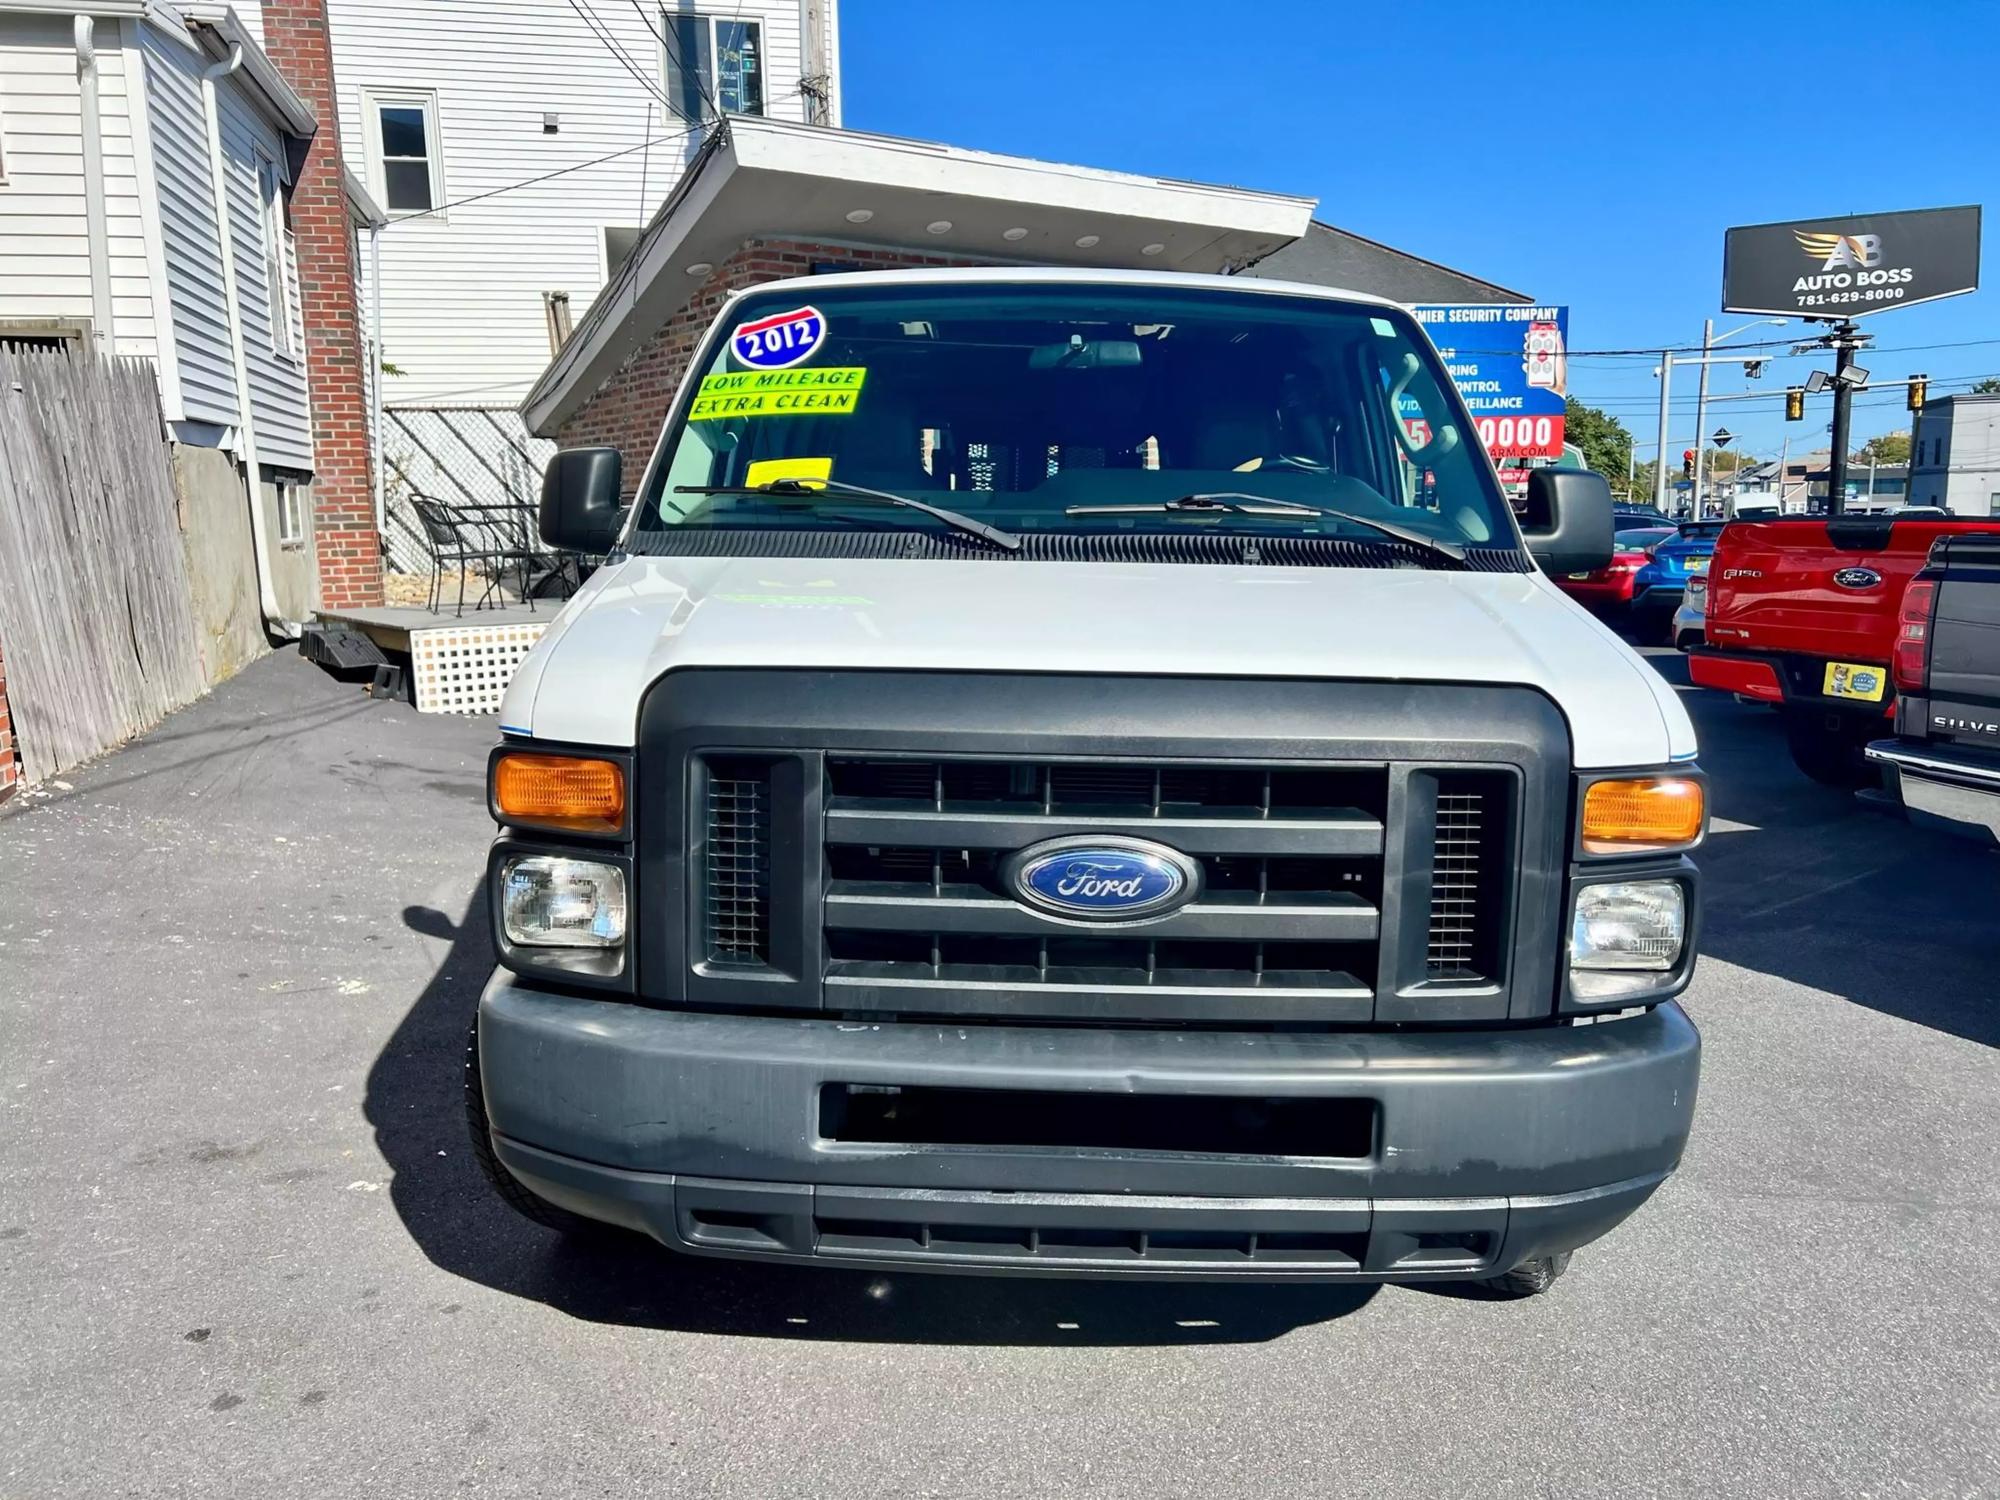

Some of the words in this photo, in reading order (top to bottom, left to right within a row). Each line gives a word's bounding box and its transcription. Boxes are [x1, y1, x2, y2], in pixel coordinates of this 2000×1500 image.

[1792, 273, 1852, 292] AUTO
[1857, 268, 1913, 286] BOSS
[1797, 288, 1904, 306] 781-629-8000
[1449, 309, 1502, 322] SECURITY
[1505, 307, 1559, 321] COMPANY
[744, 320, 814, 358] 2012
[702, 375, 749, 391] LOW
[755, 371, 858, 387] MILEAGE
[693, 397, 763, 414] EXTRA
[775, 394, 851, 409] CLEAN
[1398, 400, 1421, 411] VID
[1490, 447, 1548, 457] ARM.COM
[1842, 572, 1869, 584] Ford
[1057, 862, 1145, 897] Ford
